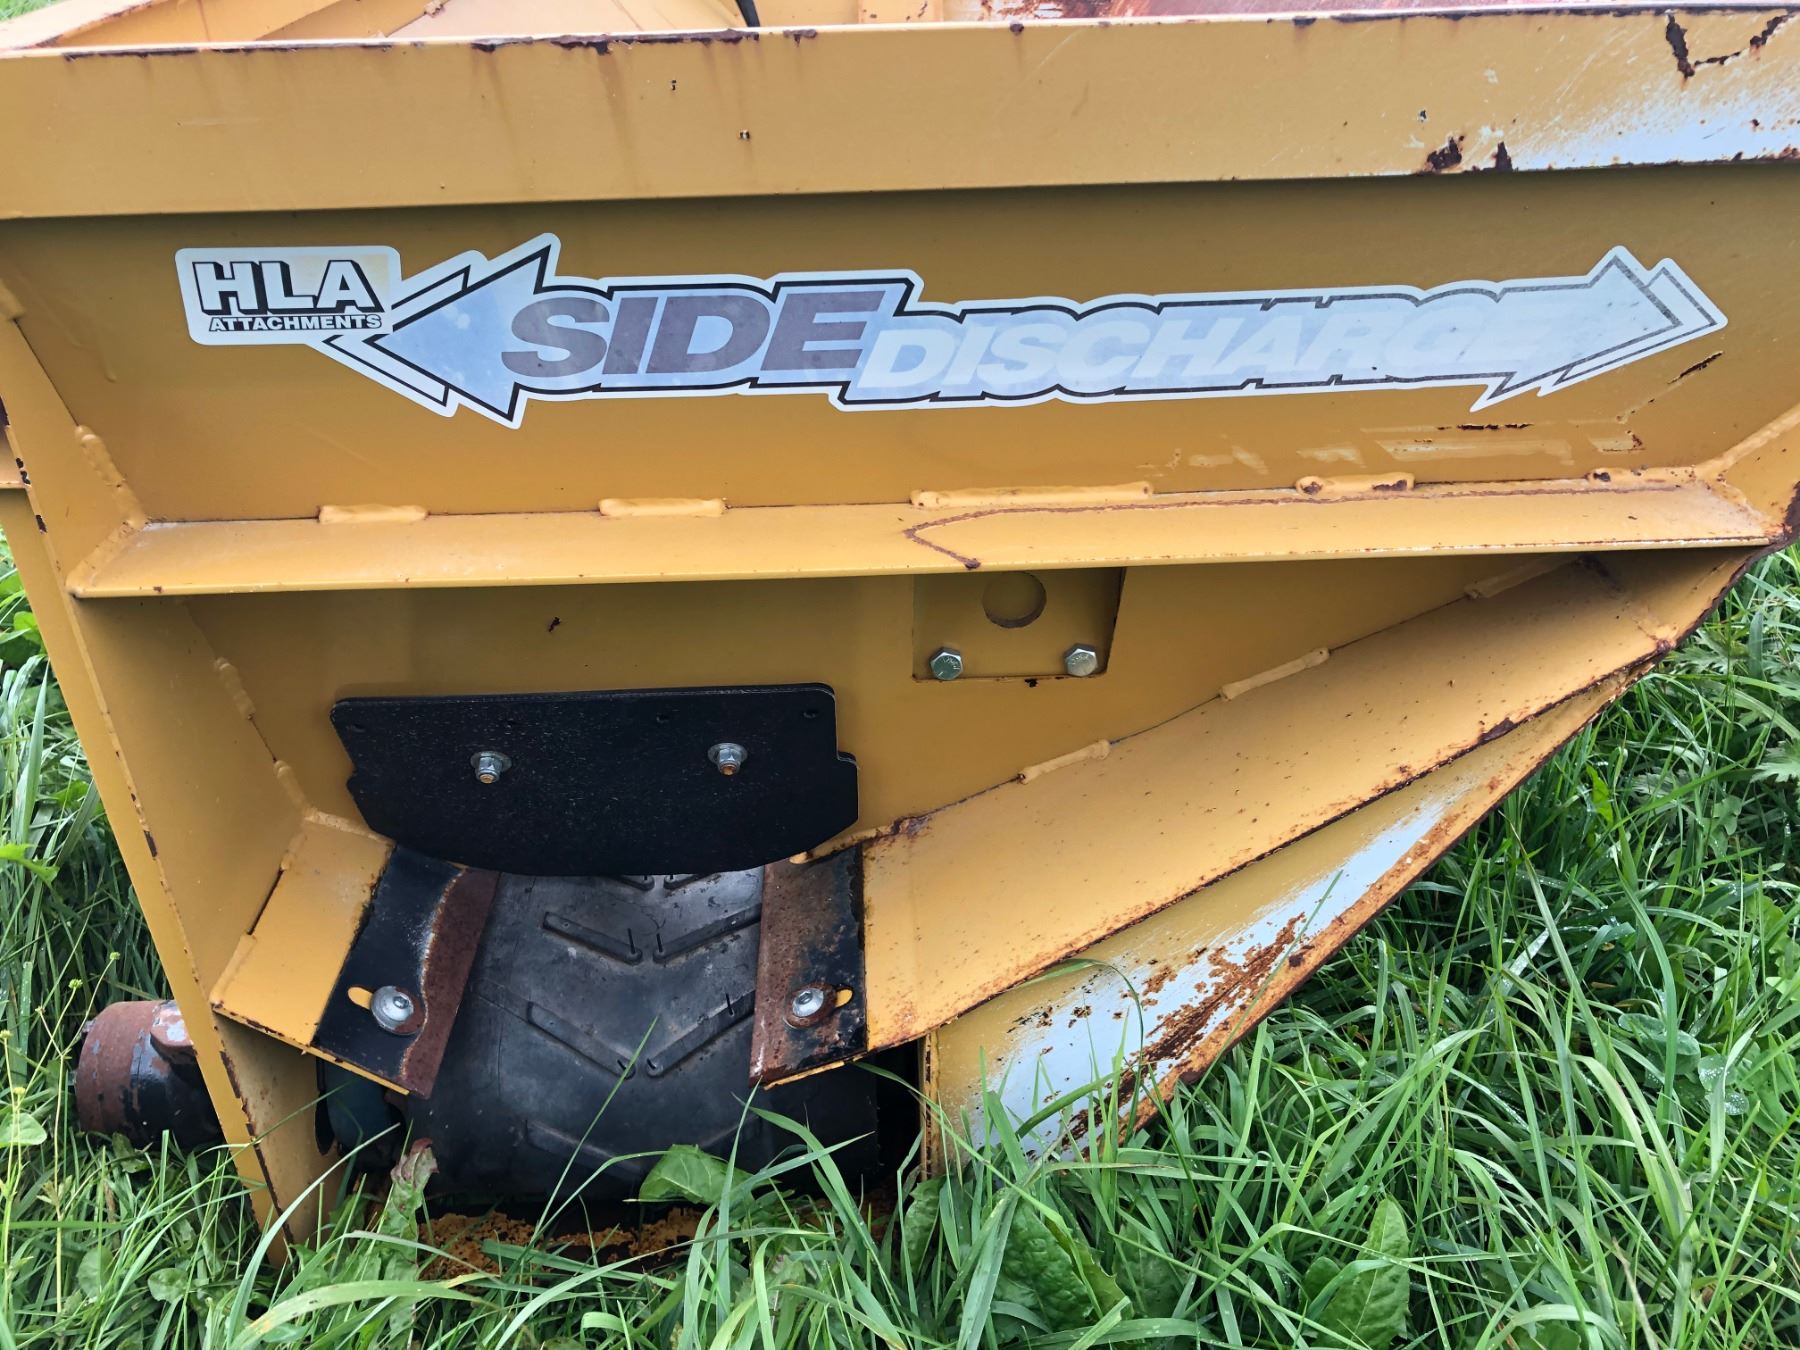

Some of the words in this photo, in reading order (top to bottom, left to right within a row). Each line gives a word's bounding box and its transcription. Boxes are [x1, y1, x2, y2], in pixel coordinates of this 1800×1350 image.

[193, 260, 385, 315] HLA
[208, 315, 382, 332] ATTACHMENTS
[501, 290, 886, 378] SIDE
[857, 304, 1552, 388] DISCHARGE
